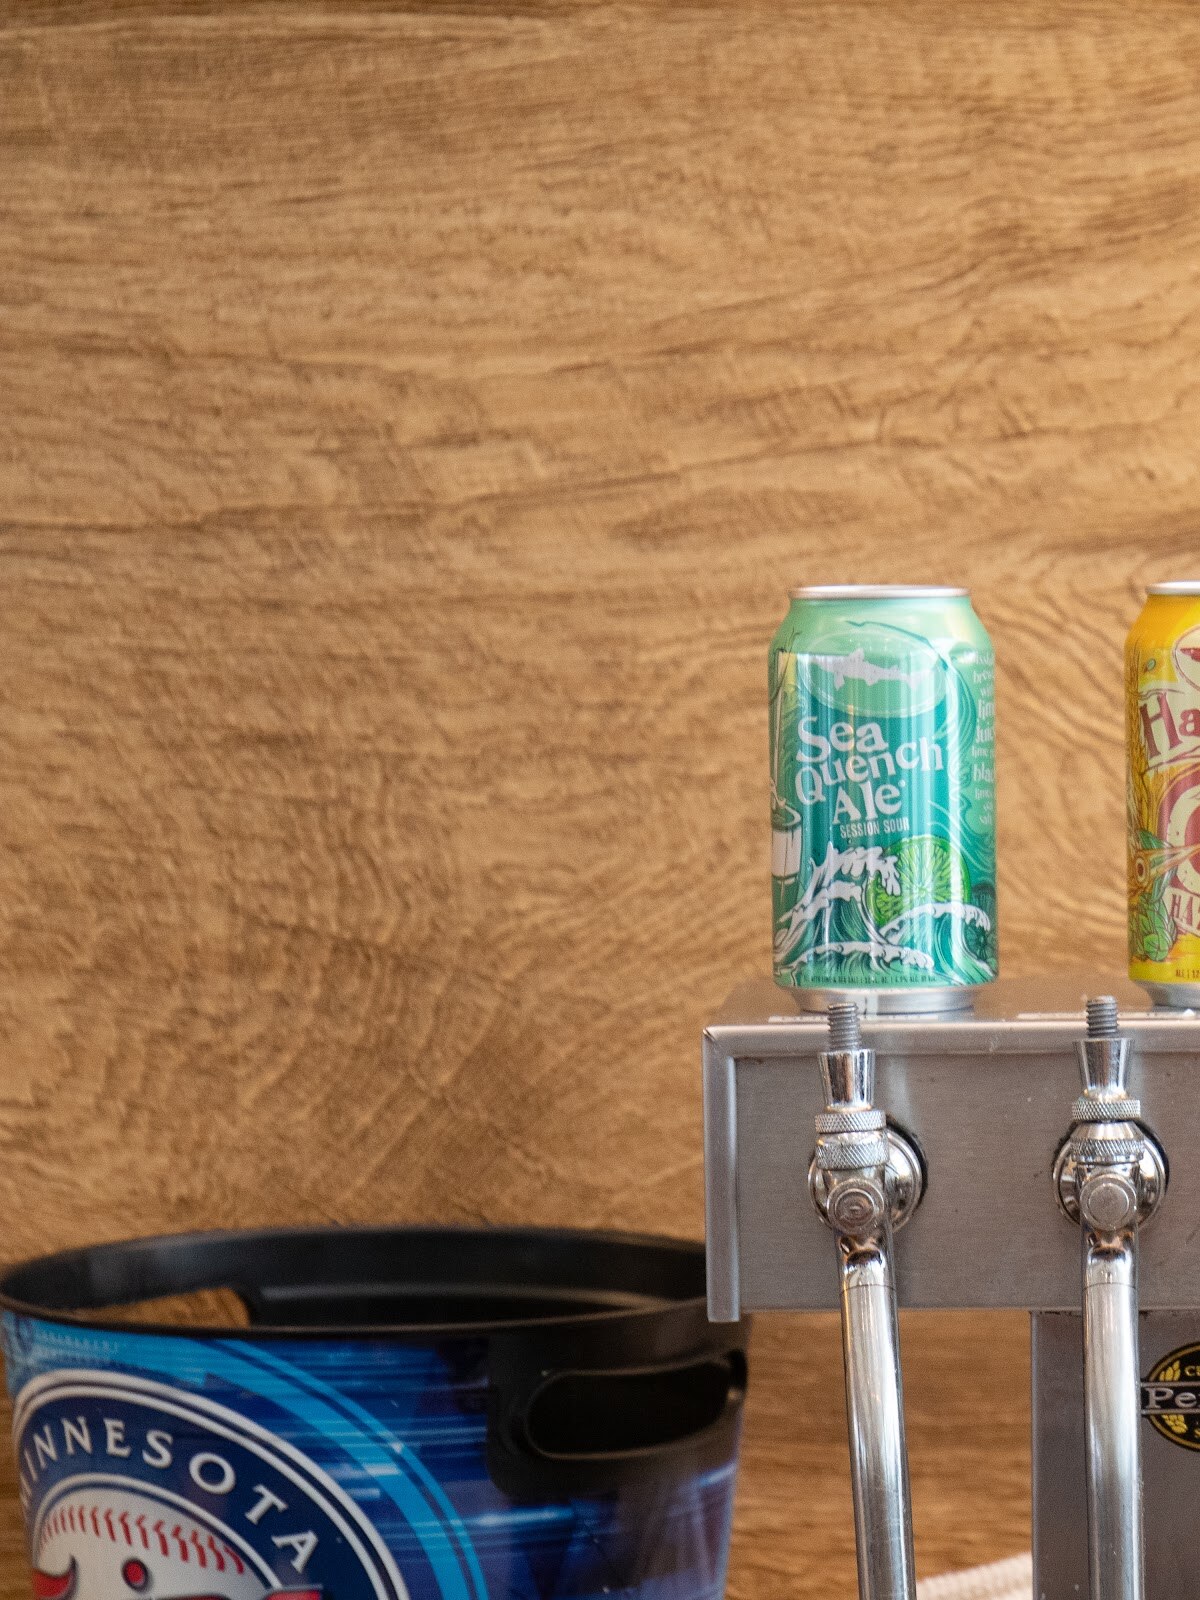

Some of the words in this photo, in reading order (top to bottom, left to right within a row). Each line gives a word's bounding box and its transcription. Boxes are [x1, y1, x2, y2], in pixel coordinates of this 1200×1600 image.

[796, 716, 888, 763] Sea
[795, 737, 943, 804] Quench
[832, 781, 901, 824] Ale
[840, 821, 880, 838] SESSION
[884, 817, 910, 834] SOUR
